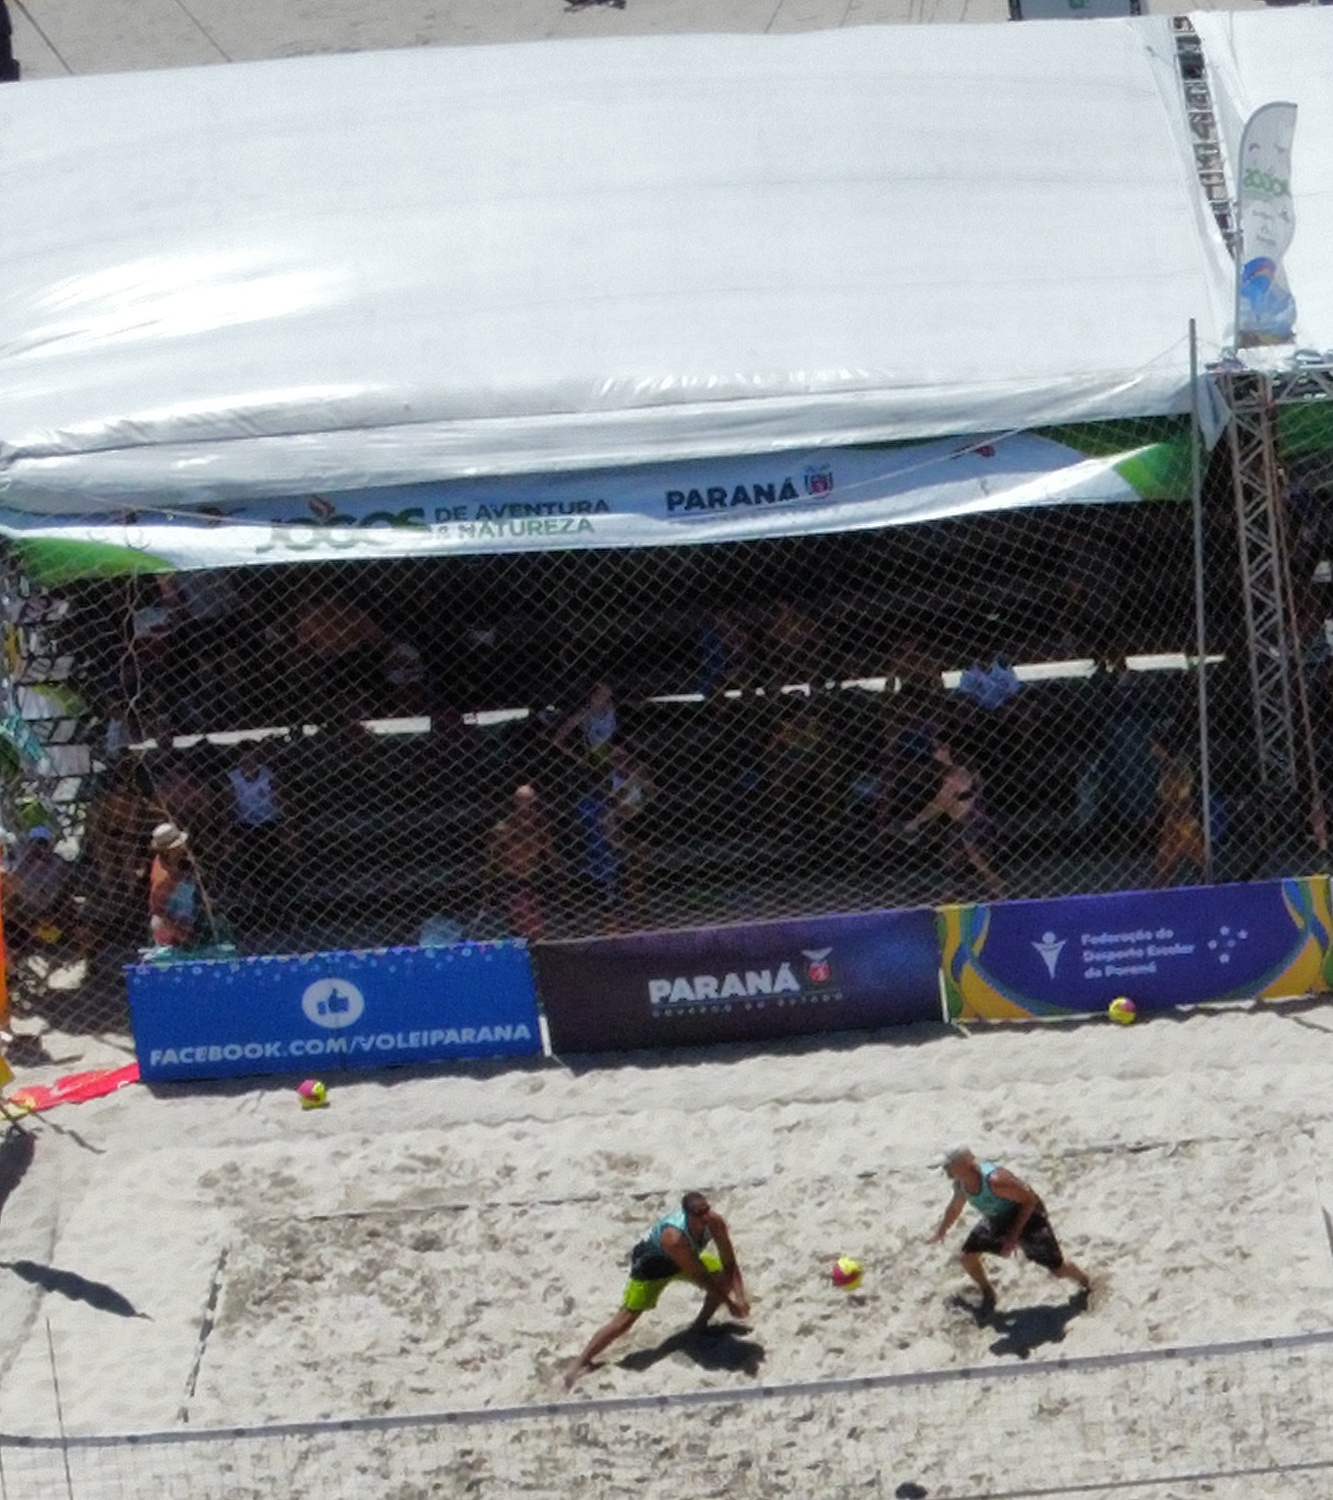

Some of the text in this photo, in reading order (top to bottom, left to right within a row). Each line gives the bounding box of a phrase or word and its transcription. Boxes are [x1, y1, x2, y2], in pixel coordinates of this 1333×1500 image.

[434, 498, 611, 523] DE AVENTURA
[666, 477, 800, 512] PARANÁ
[458, 517, 597, 541] NATUREZA
[647, 962, 801, 1005] PARANÁ
[150, 1023, 533, 1067] FACEBOOK.COM/VOLEIPARANA
